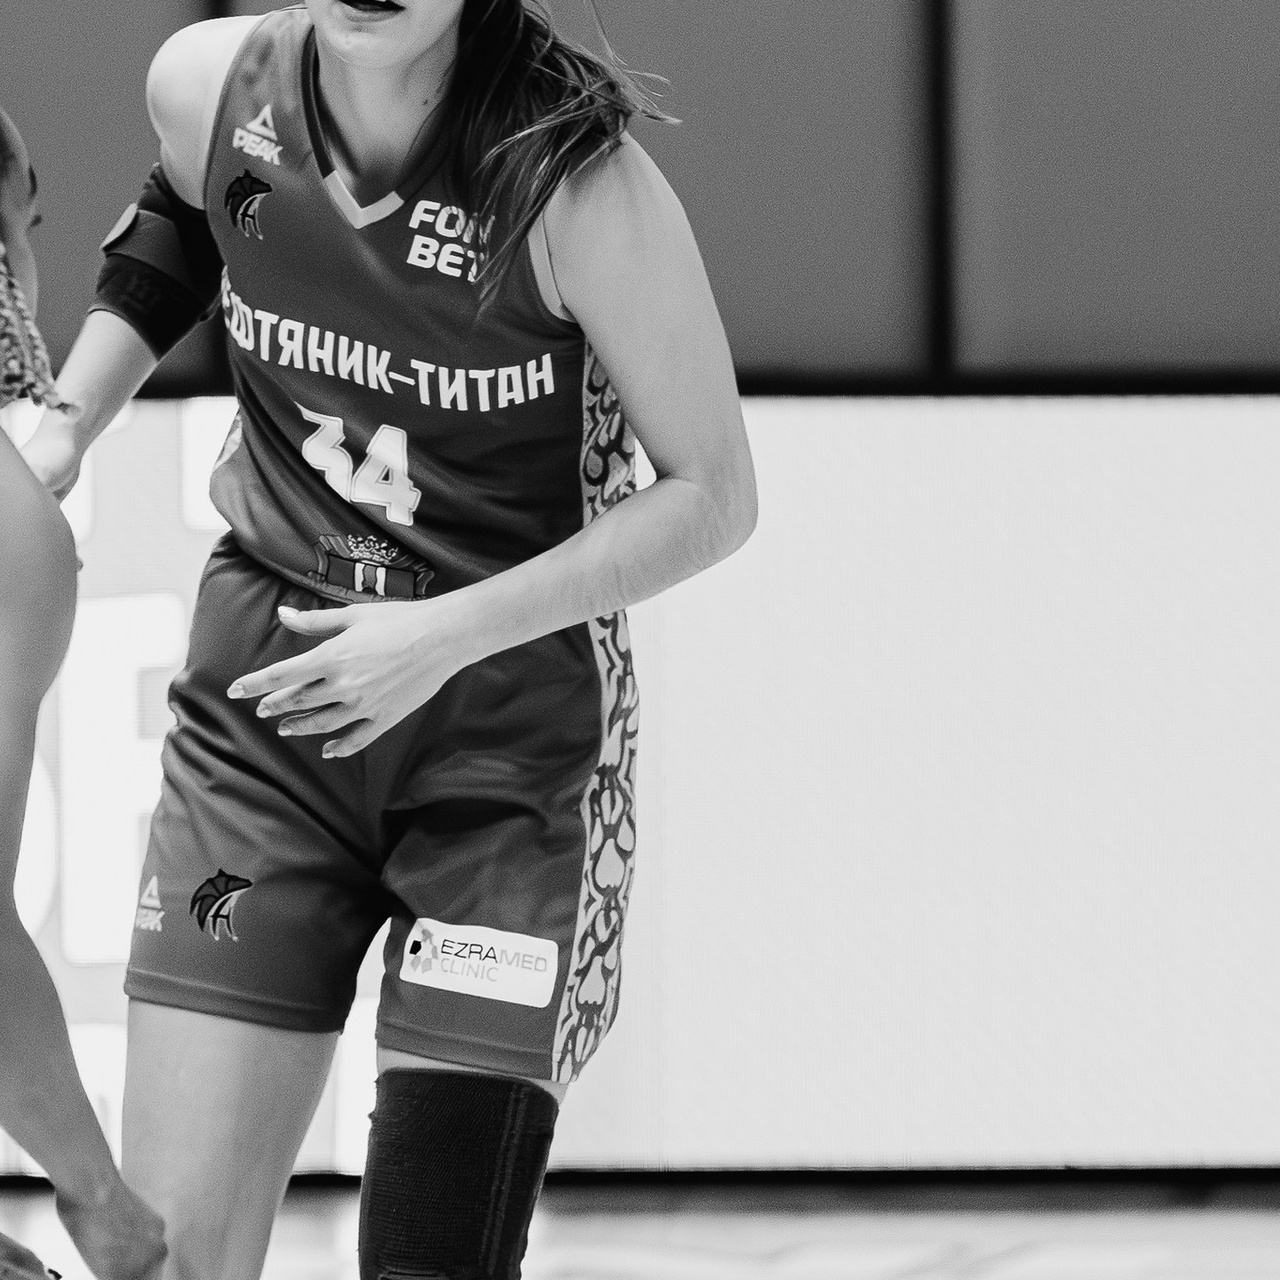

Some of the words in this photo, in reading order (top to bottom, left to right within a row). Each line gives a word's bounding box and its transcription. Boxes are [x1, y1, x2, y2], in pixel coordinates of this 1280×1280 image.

[232, 127, 283, 166] PEAK
[294, 400, 421, 526] 34
[440, 938, 548, 973] EZRAMED
[440, 957, 500, 982] CLINIC
